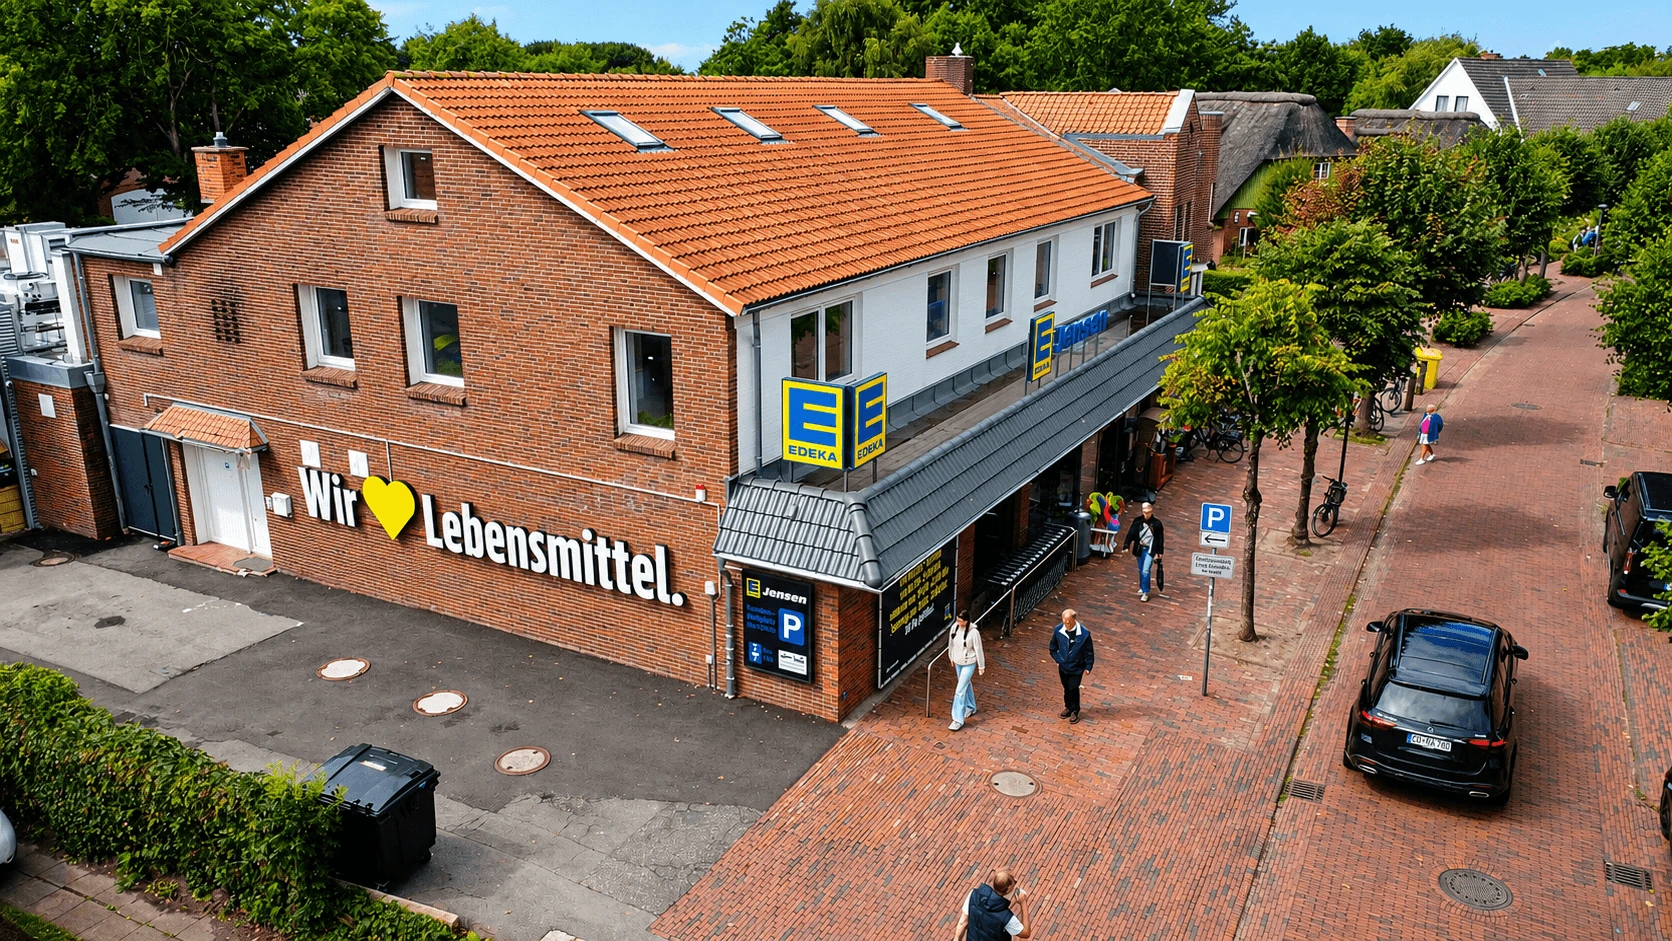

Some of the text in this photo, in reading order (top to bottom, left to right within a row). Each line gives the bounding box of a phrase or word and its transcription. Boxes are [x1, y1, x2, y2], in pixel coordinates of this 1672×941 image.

[1036, 318, 1053, 364] E
[1053, 310, 1109, 353] Jensen
[788, 387, 837, 448] E
[858, 381, 883, 446] E
[788, 445, 837, 462] EDEKA
[858, 438, 883, 460] EDEKA
[1207, 507, 1225, 528] P
[297, 466, 686, 607] Wir Lebensmittel.
[762, 587, 808, 605] Jensen
[783, 613, 802, 639] P
